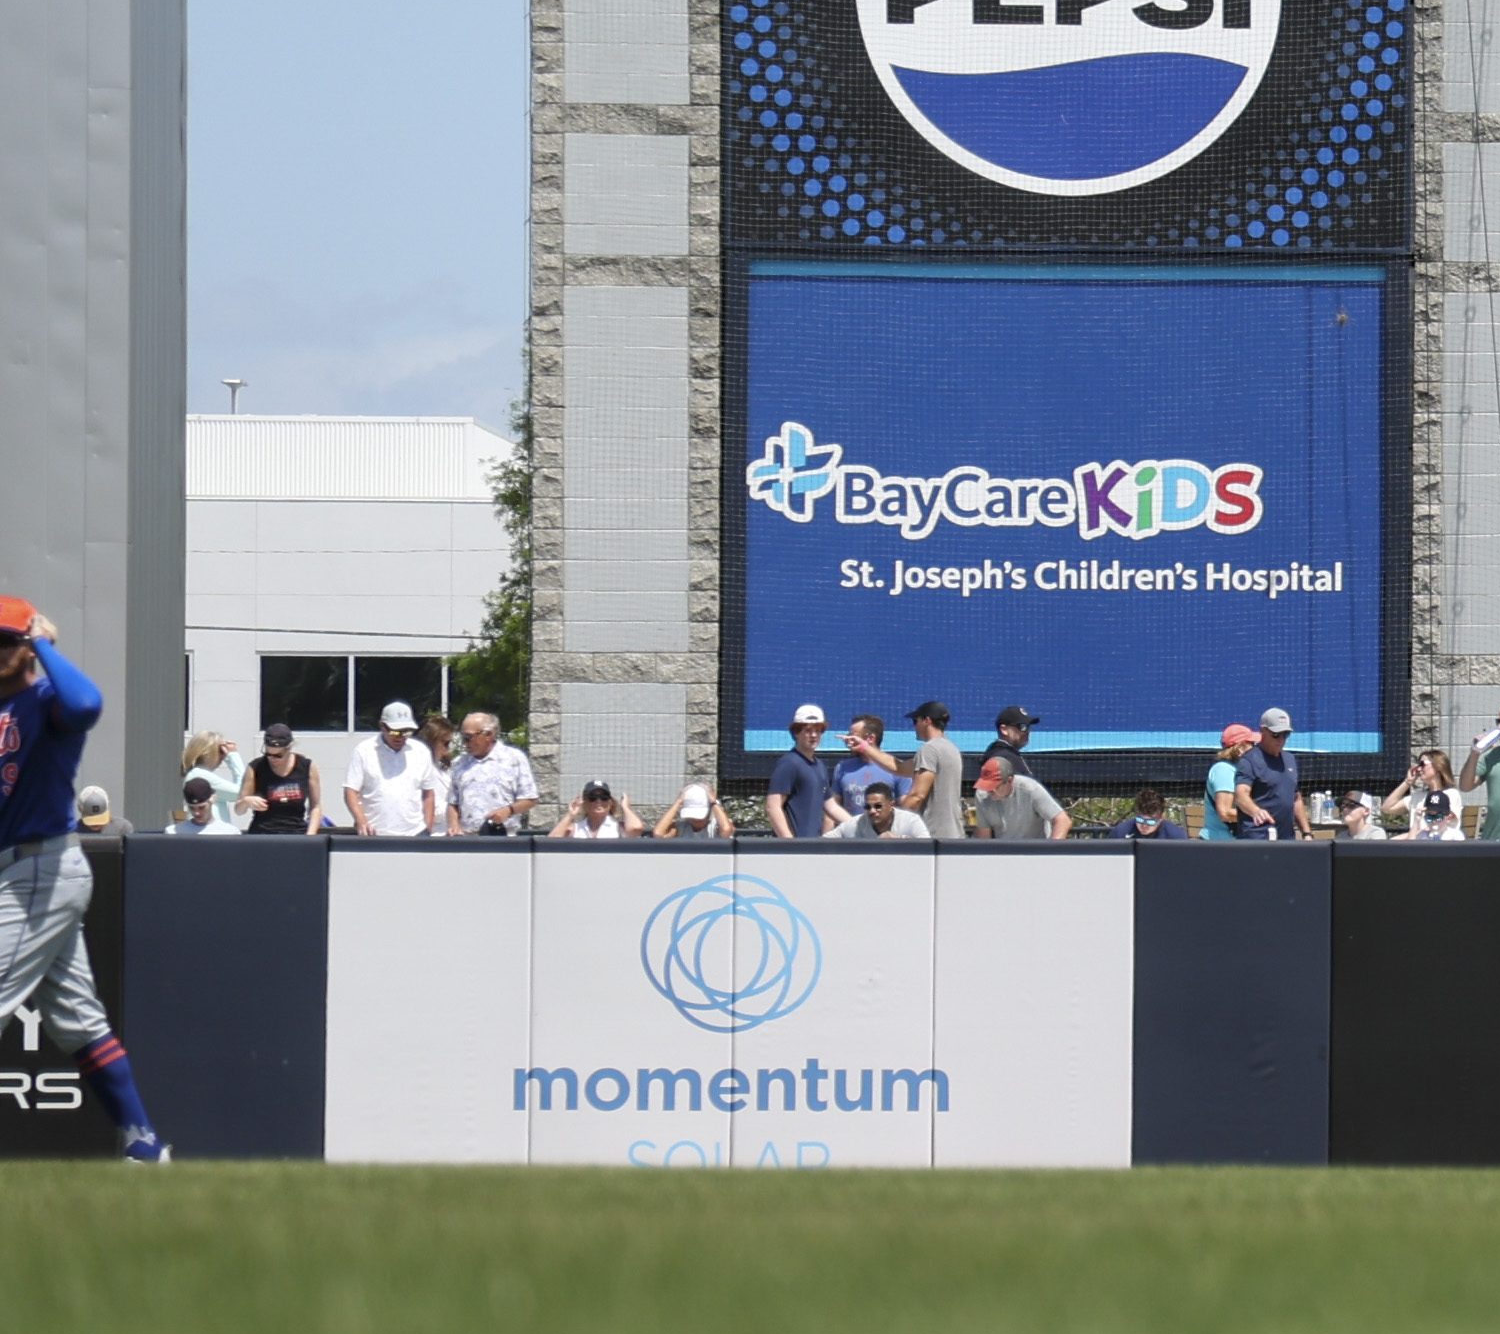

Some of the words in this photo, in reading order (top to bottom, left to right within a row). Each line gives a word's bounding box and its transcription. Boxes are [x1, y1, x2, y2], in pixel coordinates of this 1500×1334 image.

[841, 559, 884, 588] St.
[891, 559, 1027, 597] Joseph's
[1035, 560, 1197, 590] Children's
[1207, 561, 1343, 598] Hospital
[513, 1058, 950, 1112] momentum
